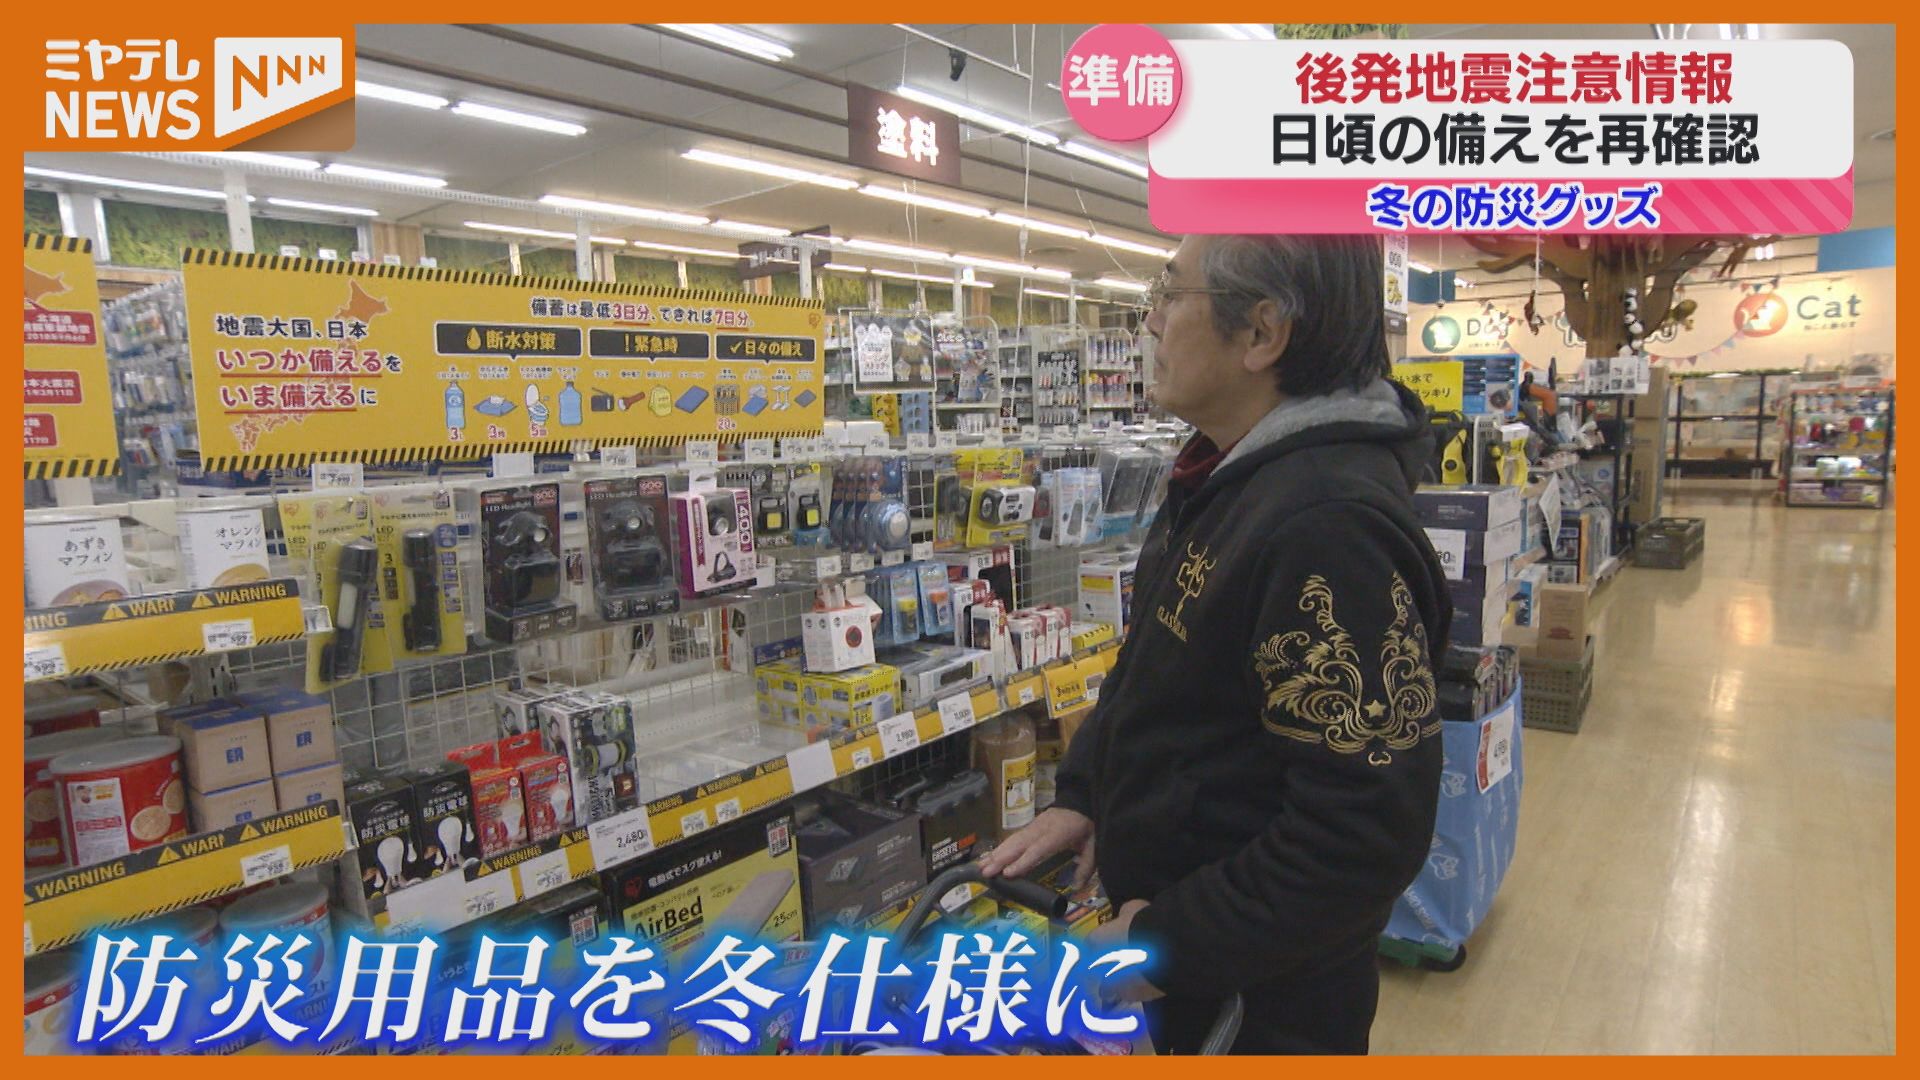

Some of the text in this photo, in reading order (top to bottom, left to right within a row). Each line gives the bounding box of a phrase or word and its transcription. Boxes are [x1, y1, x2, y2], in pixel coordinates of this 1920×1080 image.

[877, 107, 939, 166] 塗料
[1797, 294, 1861, 320] Cat
[216, 316, 368, 339] 地震大国、日本
[486, 330, 557, 350] 断水対策
[745, 341, 803, 357] 日々の備え
[218, 349, 402, 373] いつか備えるを
[219, 384, 377, 408] いま備えるに
[738, 504, 751, 545] 400
[64, 536, 106, 551] あずき
[219, 538, 262, 551] マフィン
[58, 552, 113, 567] マフィン
[215, 584, 287, 605] WARNING
[296, 731, 313, 748] ER
[226, 747, 244, 764] ER
[423, 796, 468, 818] 防災電球
[261, 805, 328, 835] WARNING
[361, 814, 410, 840] 防災電球
[493, 847, 542, 871] WARNING
[35, 861, 125, 899] WARNING
[634, 895, 703, 940] AirBed
